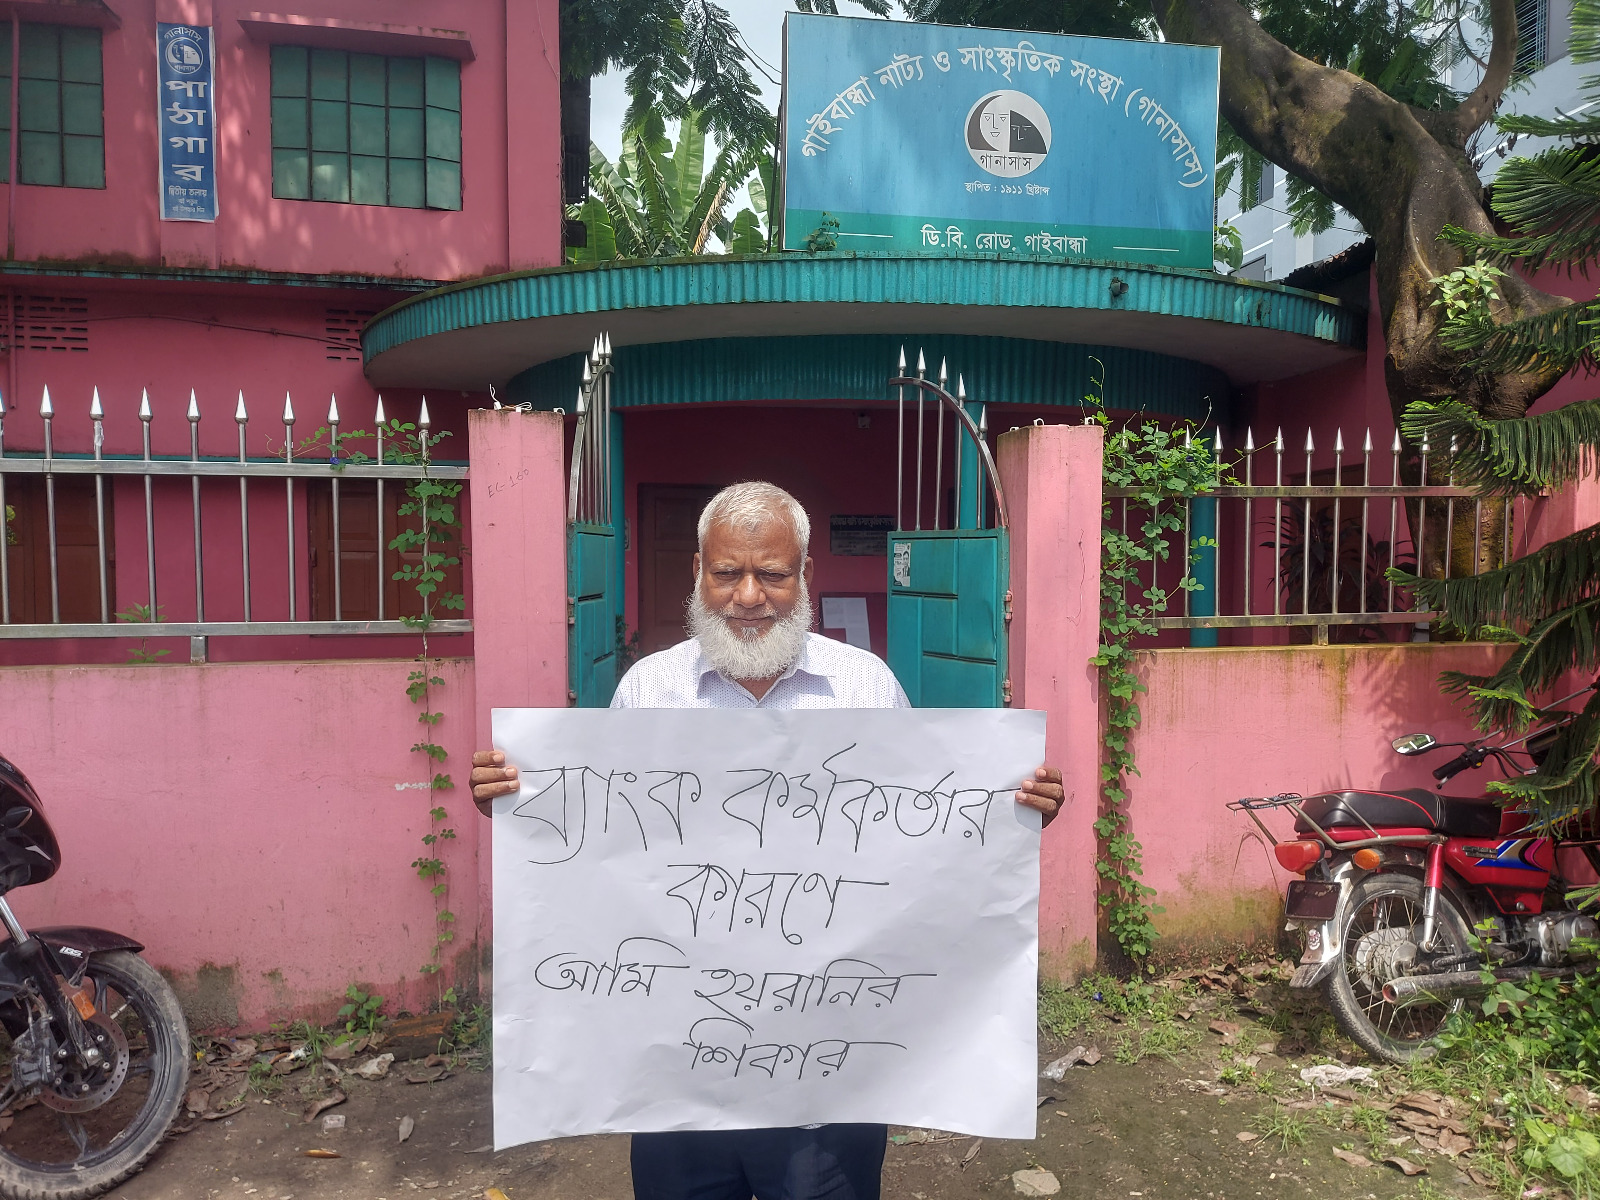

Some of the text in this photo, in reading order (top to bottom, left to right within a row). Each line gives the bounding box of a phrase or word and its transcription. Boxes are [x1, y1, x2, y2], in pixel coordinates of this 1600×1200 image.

[801, 75, 876, 157] গাইবান্ধা
[873, 53, 924, 89] নাট্য
[932, 51, 951, 73] ও
[957, 40, 1064, 83] সাংস্কৃতিক
[1070, 59, 1124, 105] সংস্থা
[964, 180, 991, 194] স্থাপিত
[1000, 184, 1023, 195] ১৯১১
[980, 153, 1033, 171] গানাসাস
[1024, 230, 1088, 255] গাইবান্ধা
[512, 765, 702, 865] ব্যাংক
[666, 862, 890, 945] কারণে
[534, 936, 938, 1032] আমি হয়রানির
[682, 1017, 908, 1080] শিকার
